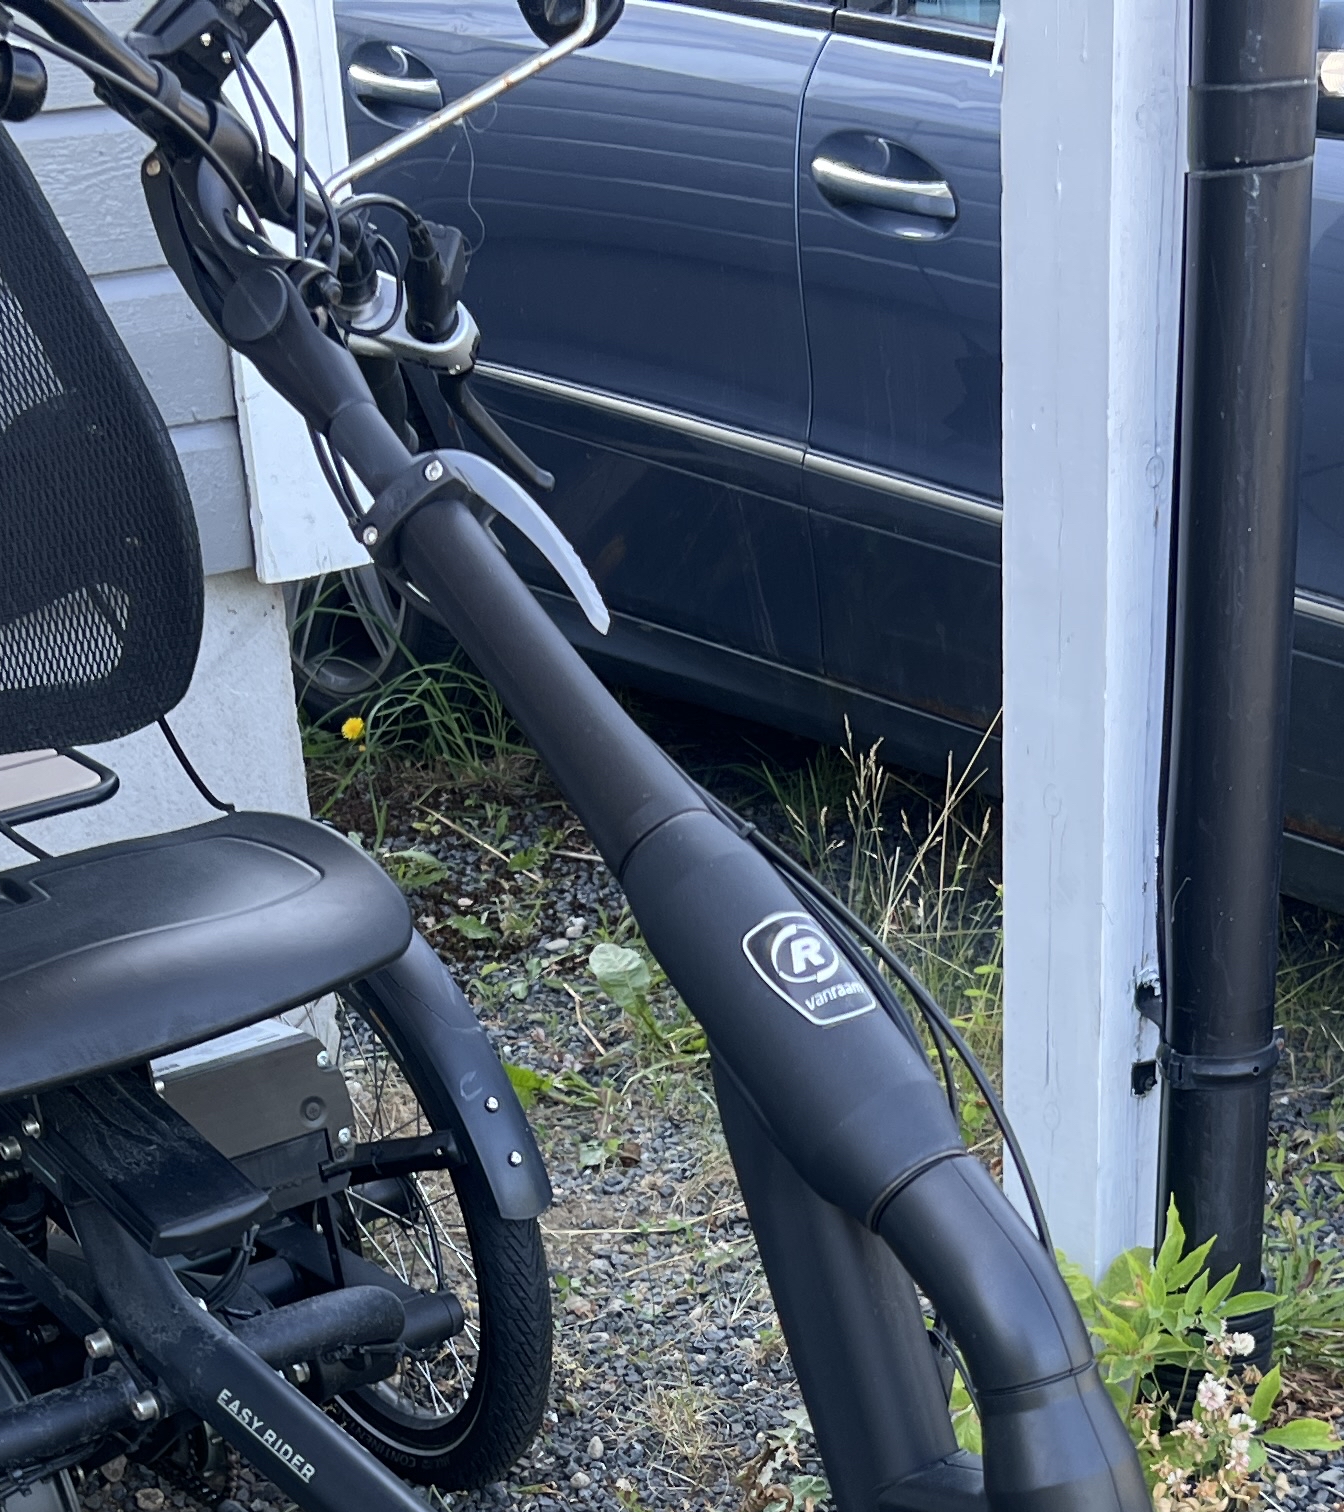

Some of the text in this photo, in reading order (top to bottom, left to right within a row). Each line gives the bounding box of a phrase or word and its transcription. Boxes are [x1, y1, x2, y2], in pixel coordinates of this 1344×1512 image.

[789, 936, 826, 975] R
[805, 981, 865, 1011] vanraam
[217, 1388, 317, 1481] EASY RIDER
